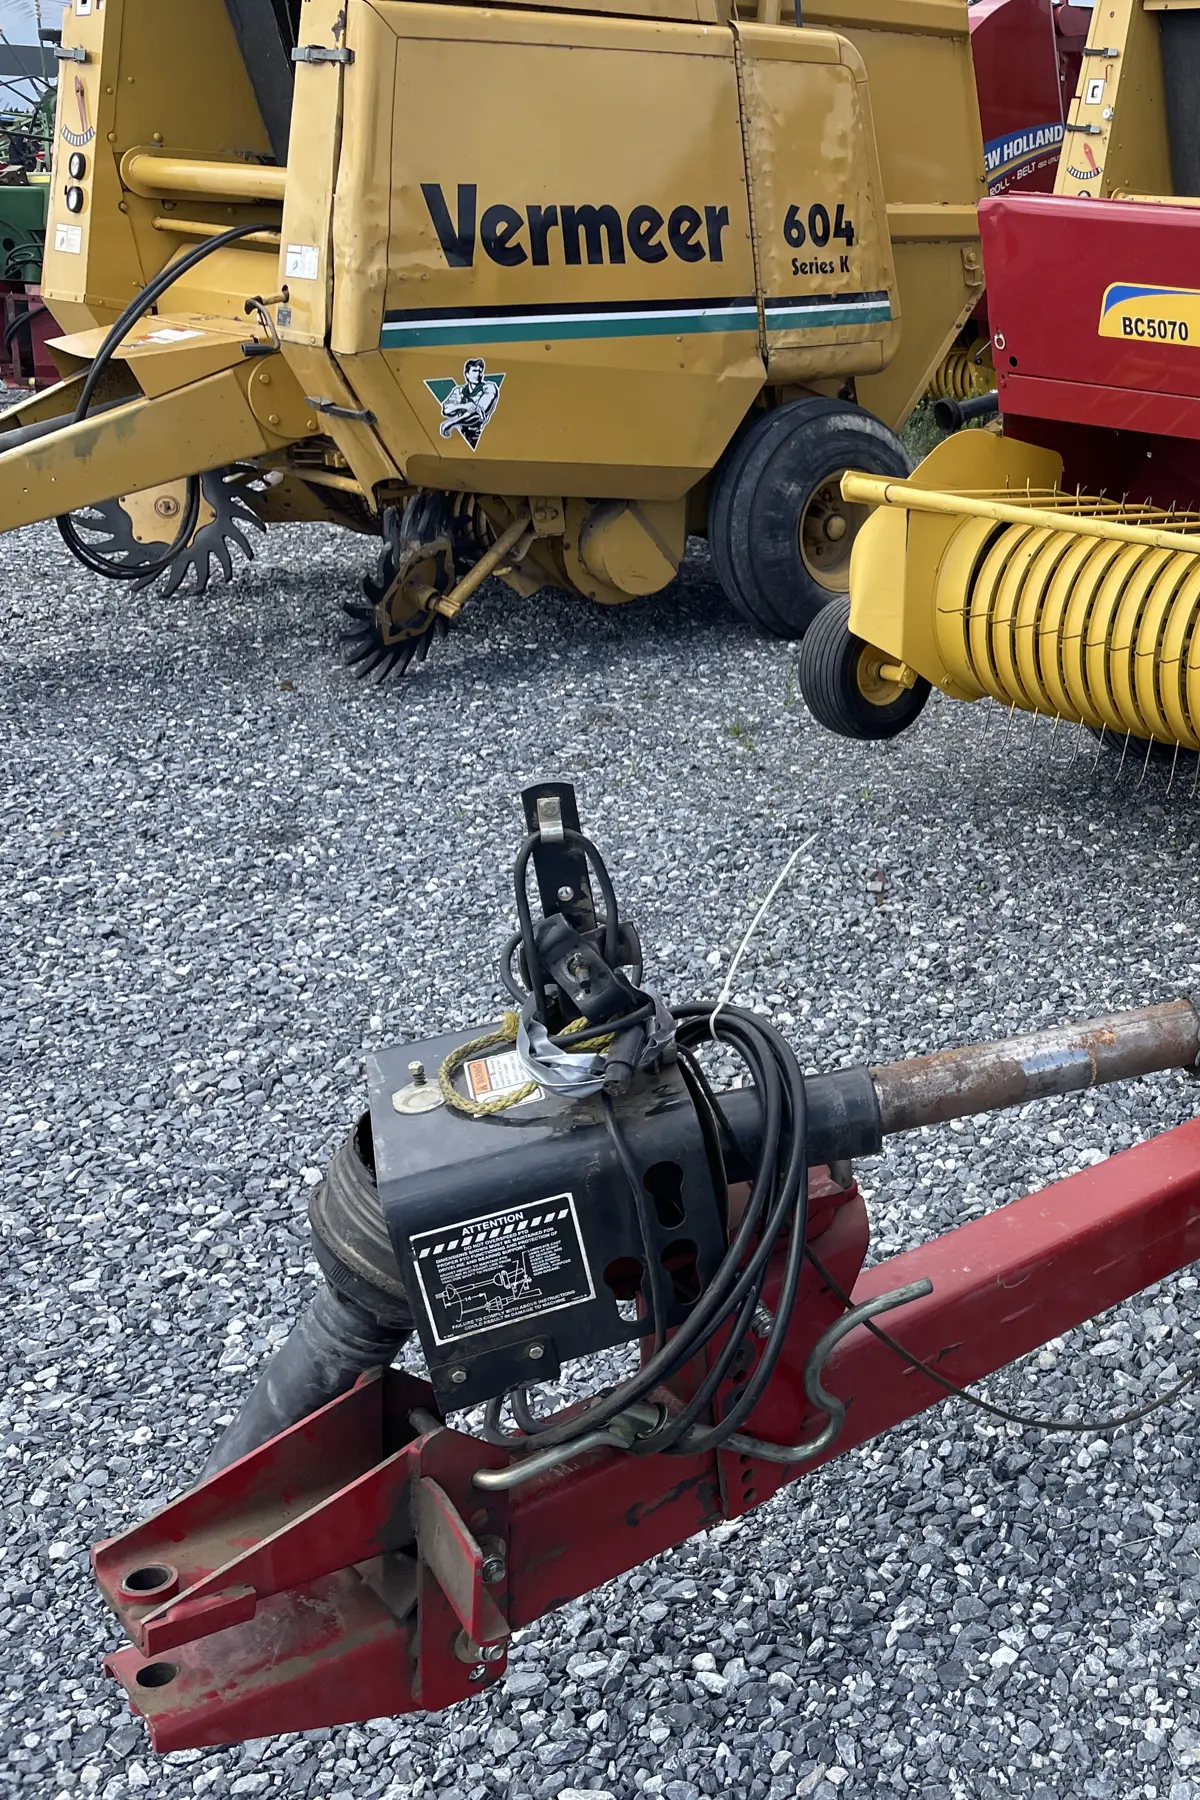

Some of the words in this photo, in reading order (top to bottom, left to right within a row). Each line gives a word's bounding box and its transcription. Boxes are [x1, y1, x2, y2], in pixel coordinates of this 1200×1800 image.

[1003, 125, 1063, 161] HOLLAND
[989, 178, 1010, 196] ROLL
[1017, 161, 1036, 180] BELT
[420, 183, 729, 268] Vermeer
[783, 203, 855, 248] 604
[791, 256, 835, 275] Series
[839, 255, 850, 273] K
[1121, 316, 1189, 342] BC5070
[460, 1211, 523, 1236] ATTENTION
[484, 1232, 517, 1245] OVERSPEED
[435, 1251, 467, 1263] DIMENSIONS
[468, 1245, 488, 1254] SHOWN
[511, 1230, 542, 1242] MAINTAINED
[436, 1258, 458, 1268] PROPER
[470, 1245, 505, 1258] FUNCTIONING
[517, 1233, 550, 1245] PROTECTION
[437, 1262, 464, 1273] DRIVELINE
[477, 1251, 501, 1261] BEARING
[451, 1319, 474, 1329] FAILURE
[482, 1310, 504, 1320] COMPLY
[537, 1289, 575, 1303] INSTRUCTIONS
[464, 1321, 482, 1330] COULD
[483, 1315, 503, 1324] RESULT
[510, 1306, 533, 1316] DAMAGE
